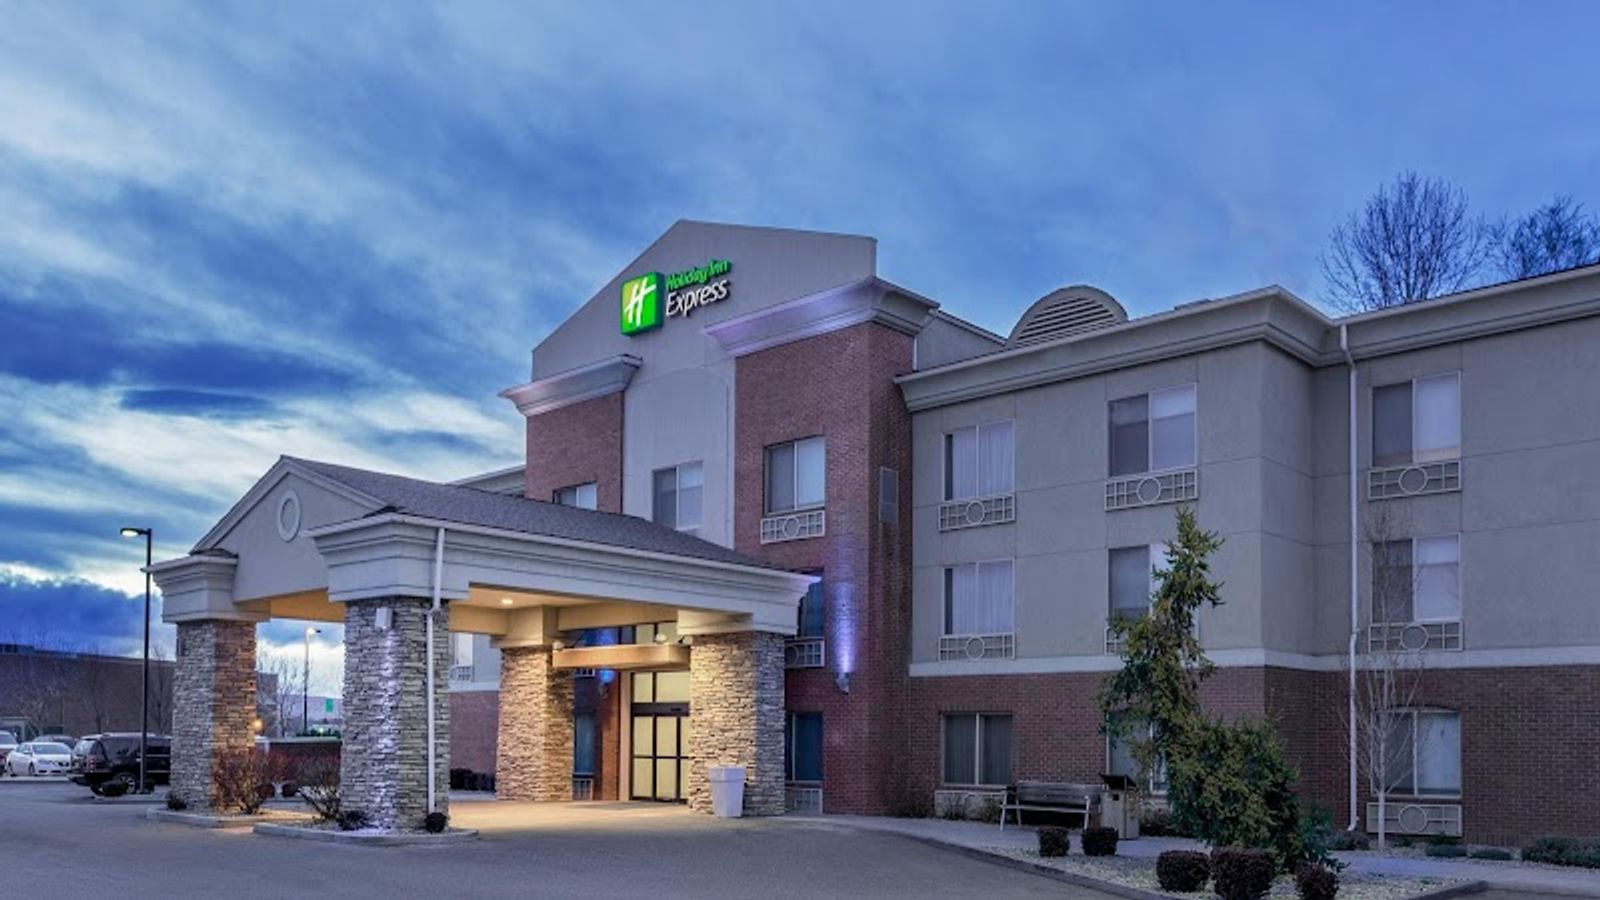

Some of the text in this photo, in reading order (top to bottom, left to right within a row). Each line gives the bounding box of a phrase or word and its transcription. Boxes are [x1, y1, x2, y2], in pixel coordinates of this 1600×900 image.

[666, 259, 728, 291] Holiday Inn
[666, 279, 728, 316] Express
